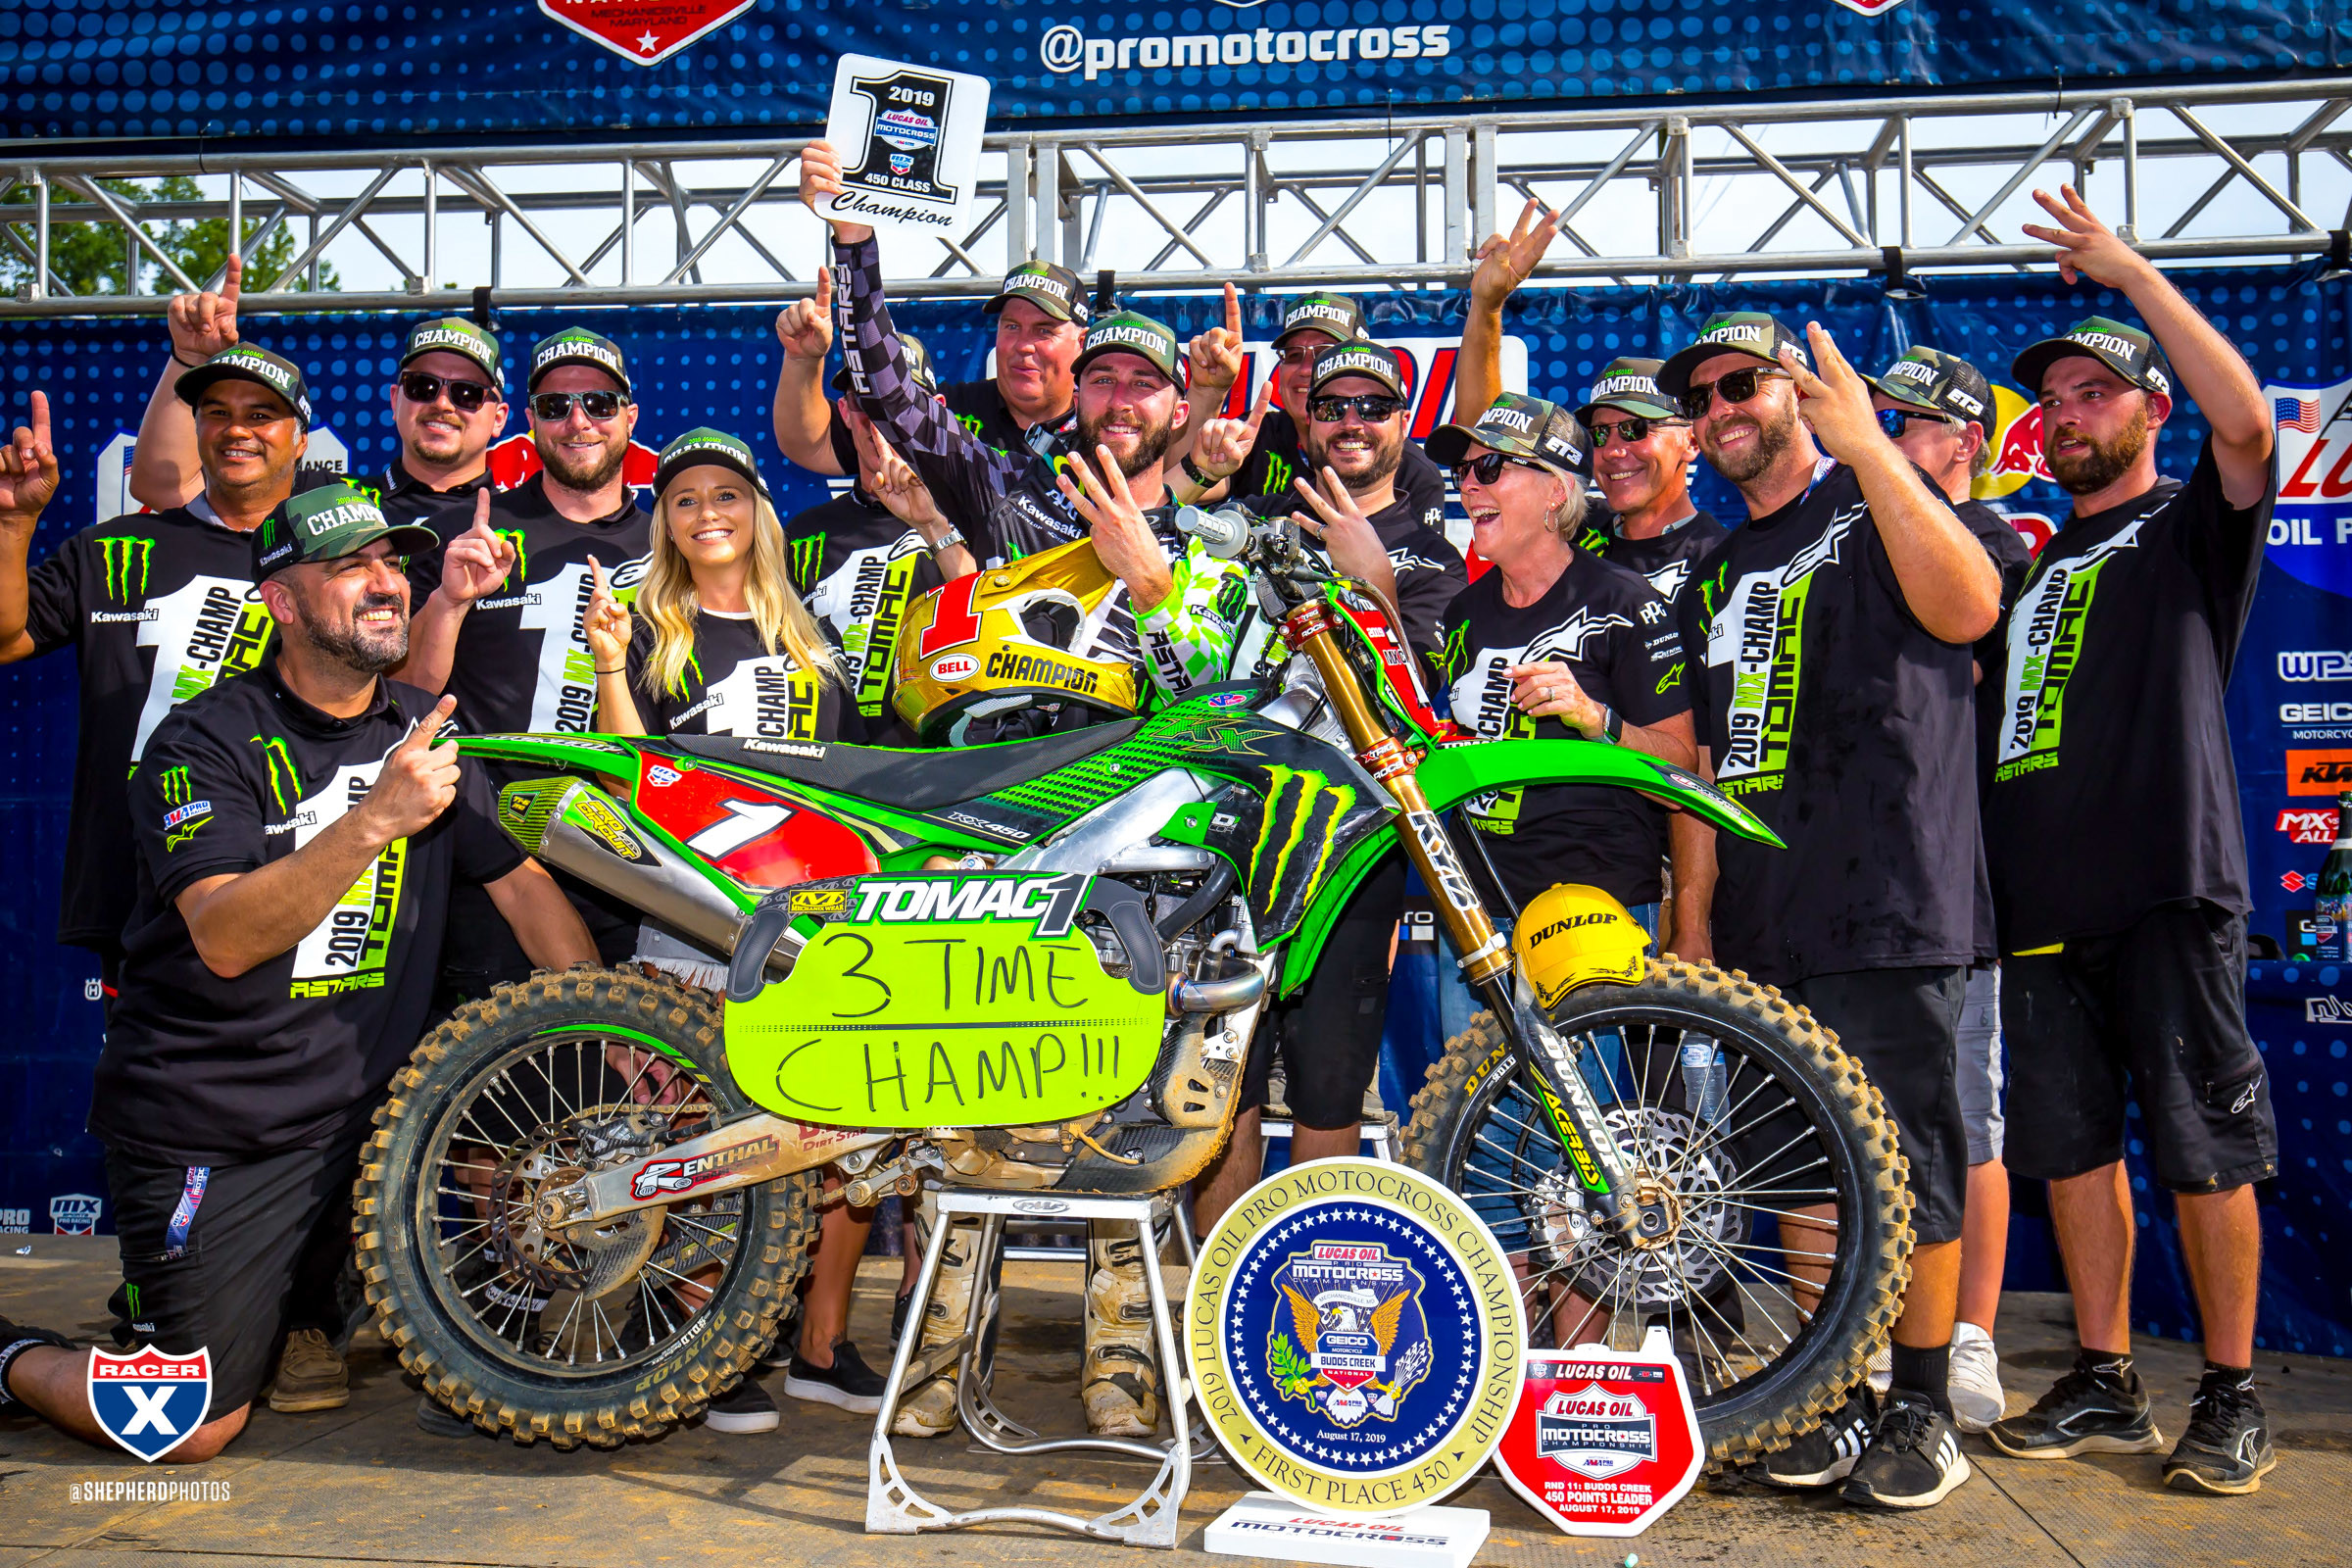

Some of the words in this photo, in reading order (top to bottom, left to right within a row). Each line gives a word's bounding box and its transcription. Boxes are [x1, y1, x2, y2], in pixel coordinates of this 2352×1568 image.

[610, 17, 687, 27] MARYLAND
[1040, 24, 1450, 79] @promotocross
[888, 85, 935, 107] 2019
[876, 123, 936, 139] MOTOCROSS
[886, 113, 913, 124] LUCAS
[914, 118, 928, 126] OIL
[864, 172, 888, 186] 450
[892, 177, 931, 193] CLASS
[831, 191, 954, 226] Champion
[1004, 273, 1069, 302] CHAMPION
[1286, 304, 1351, 327] CHAMPION
[415, 329, 492, 364] CHAMPION
[1086, 326, 1168, 356] CHAMPION
[537, 342, 618, 370] CHAMPION
[1317, 354, 1394, 379] CHAMPION
[1947, 388, 1984, 416] ET3
[1545, 436, 1584, 466] ET3
[1017, 495, 1083, 540] Kawasaki
[2266, 518, 2323, 546] OIL
[259, 543, 293, 567] Kawasaki
[475, 593, 542, 612] Kawasaki
[91, 608, 159, 623] Kawasaki
[919, 569, 987, 662] 1
[1295, 609, 1320, 624] XTRIG
[1301, 623, 1326, 637] ROCS
[1652, 632, 1679, 647] DUNLOP
[1734, 581, 1781, 710] MX-CHAMP
[937, 661, 972, 675] BELL
[986, 647, 1099, 695] CHAMPION
[1760, 597, 1801, 762] TOMAC
[555, 685, 593, 733] 2019
[669, 692, 725, 729] Kawasaki
[2279, 703, 2352, 722] GEIC
[2009, 696, 2036, 750] 2019
[744, 738, 827, 760] Kawasaki
[1363, 742, 1394, 763] XTRIG
[1728, 712, 1761, 768] 2019
[1373, 758, 1403, 780] ROCS
[1995, 751, 2059, 783] ASTARS
[164, 807, 189, 829] AMA
[189, 802, 210, 812] PRO
[588, 801, 625, 832] PRO
[265, 810, 317, 835] awasaki
[576, 803, 636, 859] CIRCUIT
[686, 797, 798, 862] 1
[947, 810, 988, 832] KX
[989, 823, 1031, 841] 450
[2278, 812, 2332, 831] MX
[2293, 831, 2333, 843] ALL
[791, 904, 823, 912] MECHANIX
[824, 904, 846, 912] WEAR
[854, 877, 1060, 921] TOMAC
[324, 910, 369, 967] 2019
[1530, 912, 1618, 950] DUNLOP
[290, 971, 385, 999] ASTARS
[823, 933, 892, 1017] 3
[904, 938, 1088, 1011] TIME
[775, 1033, 1120, 1114] CHAMP!!!
[1539, 1034, 1626, 1177] DUNLOP
[1242, 1187, 1290, 1228] PRO
[1294, 1170, 1459, 1232] MOTOCROSS
[1212, 1228, 1247, 1267] OIL
[1317, 1247, 1356, 1259] LUCAS
[1358, 1249, 1378, 1260] OIL
[1293, 1265, 1404, 1281] MOTOCROSS
[1294, 1277, 1404, 1287] CHAMPIONSHIP
[1196, 1272, 1221, 1363] LUCAS
[635, 1308, 727, 1393] DUNLOP
[1326, 1335, 1368, 1347] GEICO
[1456, 1231, 1515, 1445] CHAMPIONSHIP
[1320, 1356, 1348, 1366] BUDDS
[1348, 1357, 1376, 1368] CREEK
[1555, 1363, 1605, 1380] LUCAS
[1608, 1365, 1634, 1381] OIL
[1205, 1374, 1238, 1426] 2019
[1556, 1400, 1606, 1416] LUCAS
[1609, 1402, 1635, 1417] OIL
[1316, 1429, 1348, 1442] August
[1351, 1432, 1363, 1443] 17,
[1365, 1433, 1387, 1443] 2019
[1542, 1428, 1651, 1444] MOTOCROSS
[1543, 1441, 1651, 1449] CHAMPIONSHIP
[1252, 1446, 1323, 1495] FIRST
[1327, 1479, 1412, 1504] PLACE
[1412, 1459, 1451, 1494] 450
[1544, 1481, 1565, 1490] RND
[1567, 1482, 1582, 1491] 11:
[1584, 1483, 1617, 1492] BUDDS
[1619, 1484, 1651, 1494] CREEK
[1544, 1493, 1565, 1503] 450
[1567, 1493, 1608, 1504] POINTS
[1611, 1494, 1653, 1506] LEADER
[1559, 1504, 1597, 1513] AUGUST
[1600, 1505, 1615, 1514] 17,
[1617, 1505, 1641, 1515] 2019
[1230, 1521, 1447, 1545] MOTOCROSS
[1289, 1517, 1366, 1529] LUCAS
